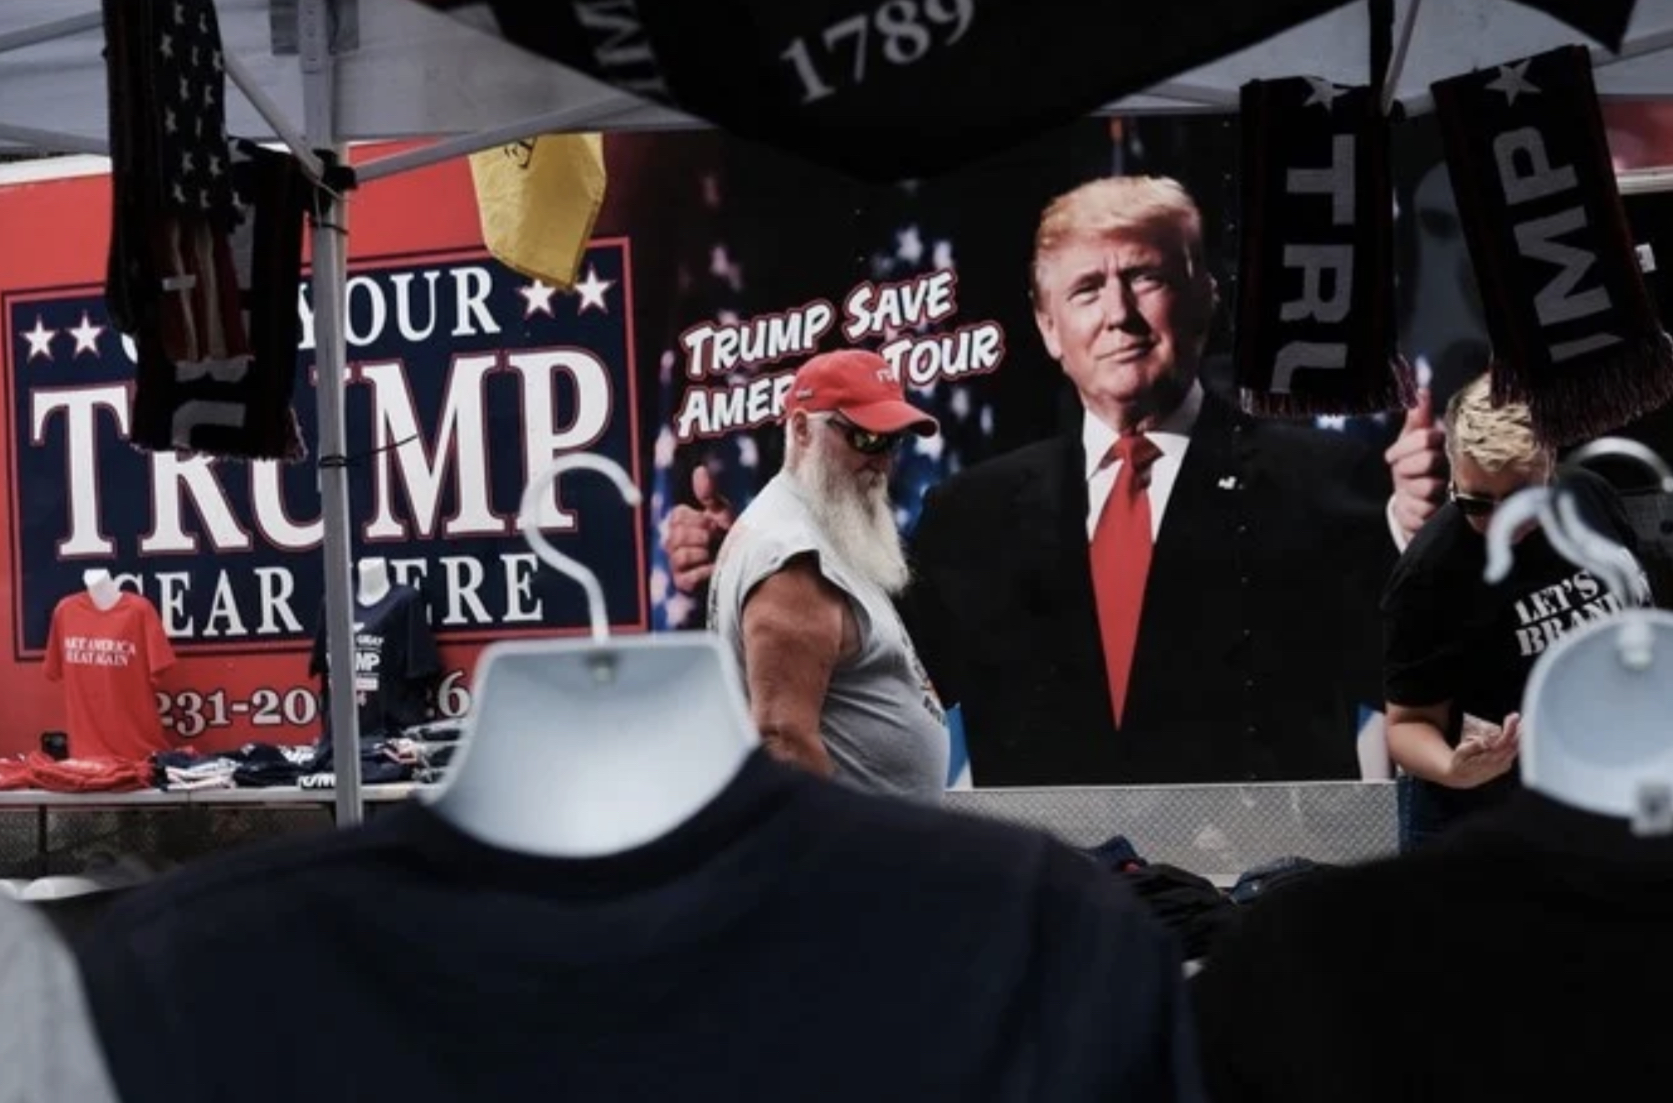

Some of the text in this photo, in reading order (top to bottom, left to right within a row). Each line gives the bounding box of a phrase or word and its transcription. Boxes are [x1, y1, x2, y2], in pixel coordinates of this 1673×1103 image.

[685, 273, 956, 376] TRUMP SAVE
[881, 326, 1002, 385] TOUR
